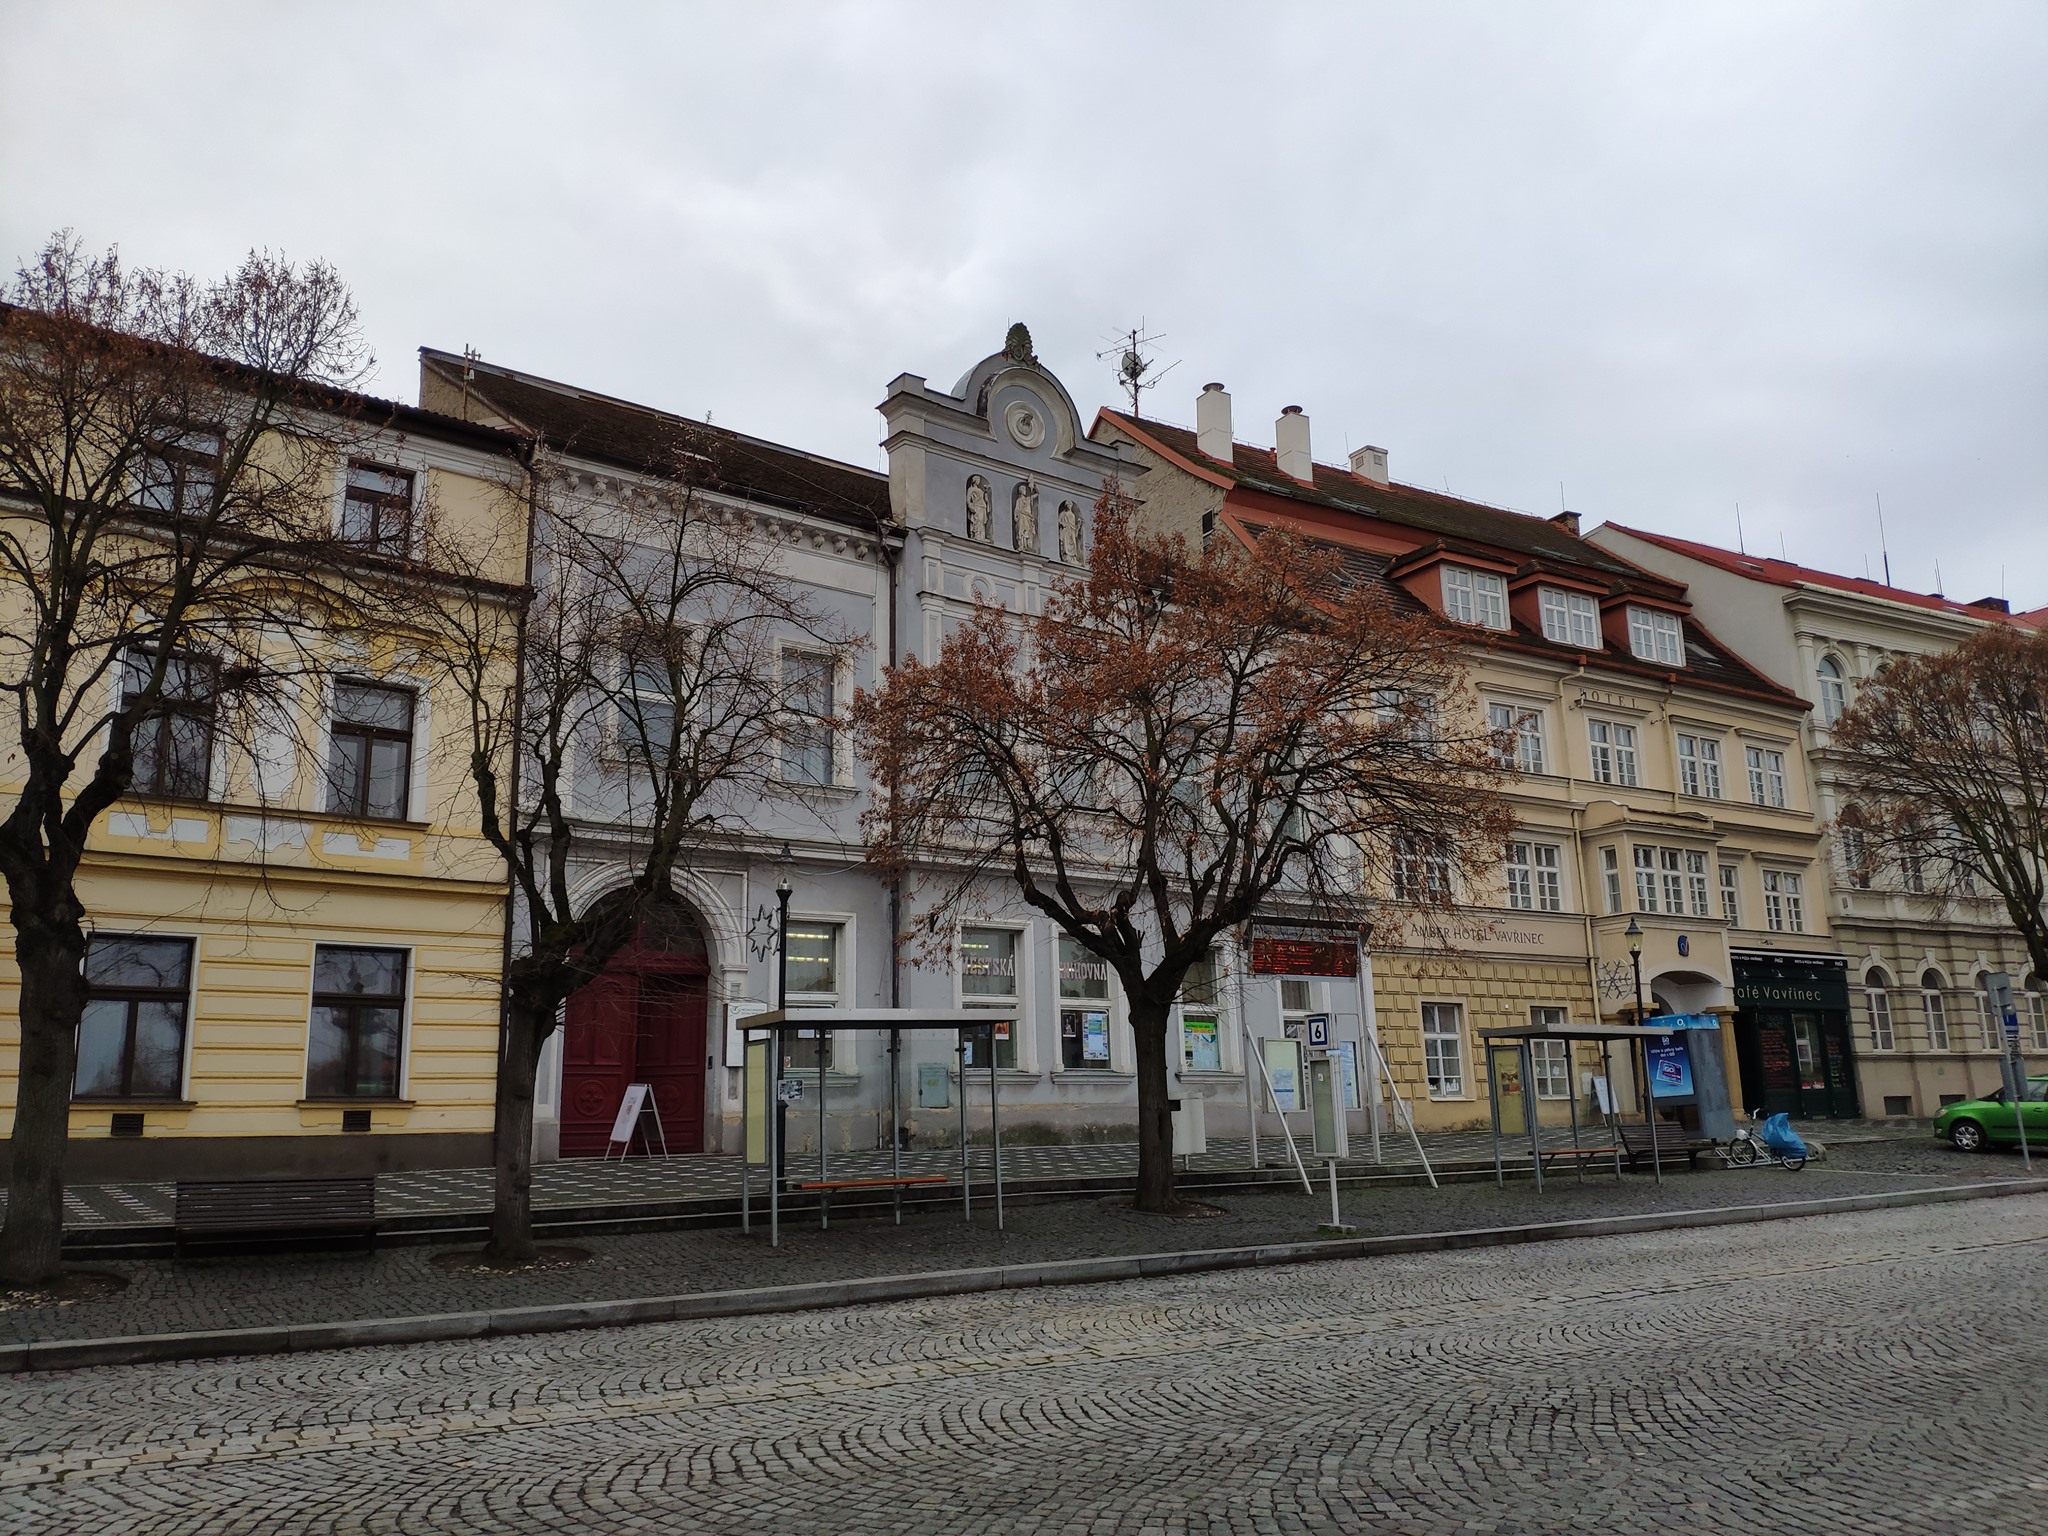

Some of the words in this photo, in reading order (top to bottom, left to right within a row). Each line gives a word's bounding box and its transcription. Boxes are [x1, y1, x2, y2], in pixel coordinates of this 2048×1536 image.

[1579, 687, 1640, 709] HOTEL
[1453, 927, 1491, 941] HOTEL
[1493, 929, 1545, 945] VAVŘINEC
[1737, 985, 1760, 999] afé
[1762, 986, 1821, 1001] Vavřinec
[1314, 1024, 1322, 1039] 6
